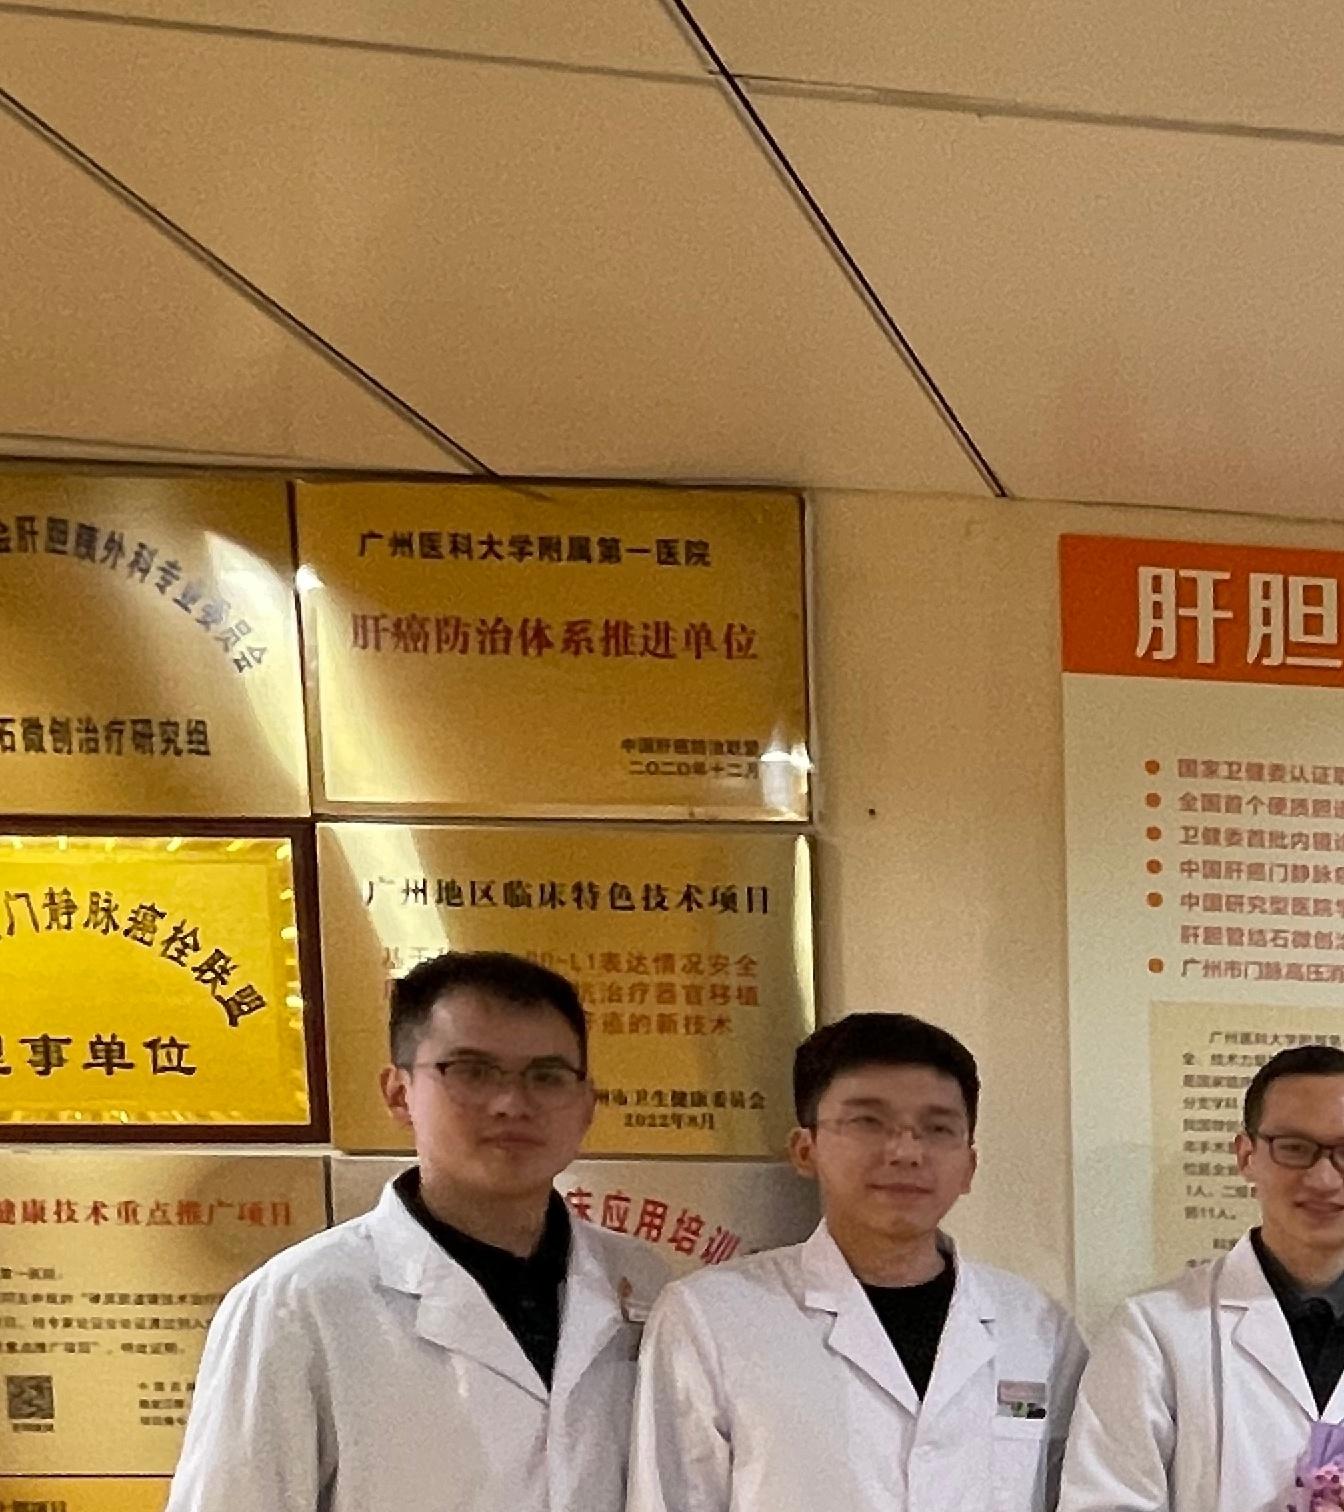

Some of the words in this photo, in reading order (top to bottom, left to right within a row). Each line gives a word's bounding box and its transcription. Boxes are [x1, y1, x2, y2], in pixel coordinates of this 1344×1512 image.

[358, 530, 712, 568] 广州医科大学附属第一医院
[351, 612, 759, 660] 肝癌防治体系推进单位
[367, 877, 770, 915] 广州地区临床特色技术项目
